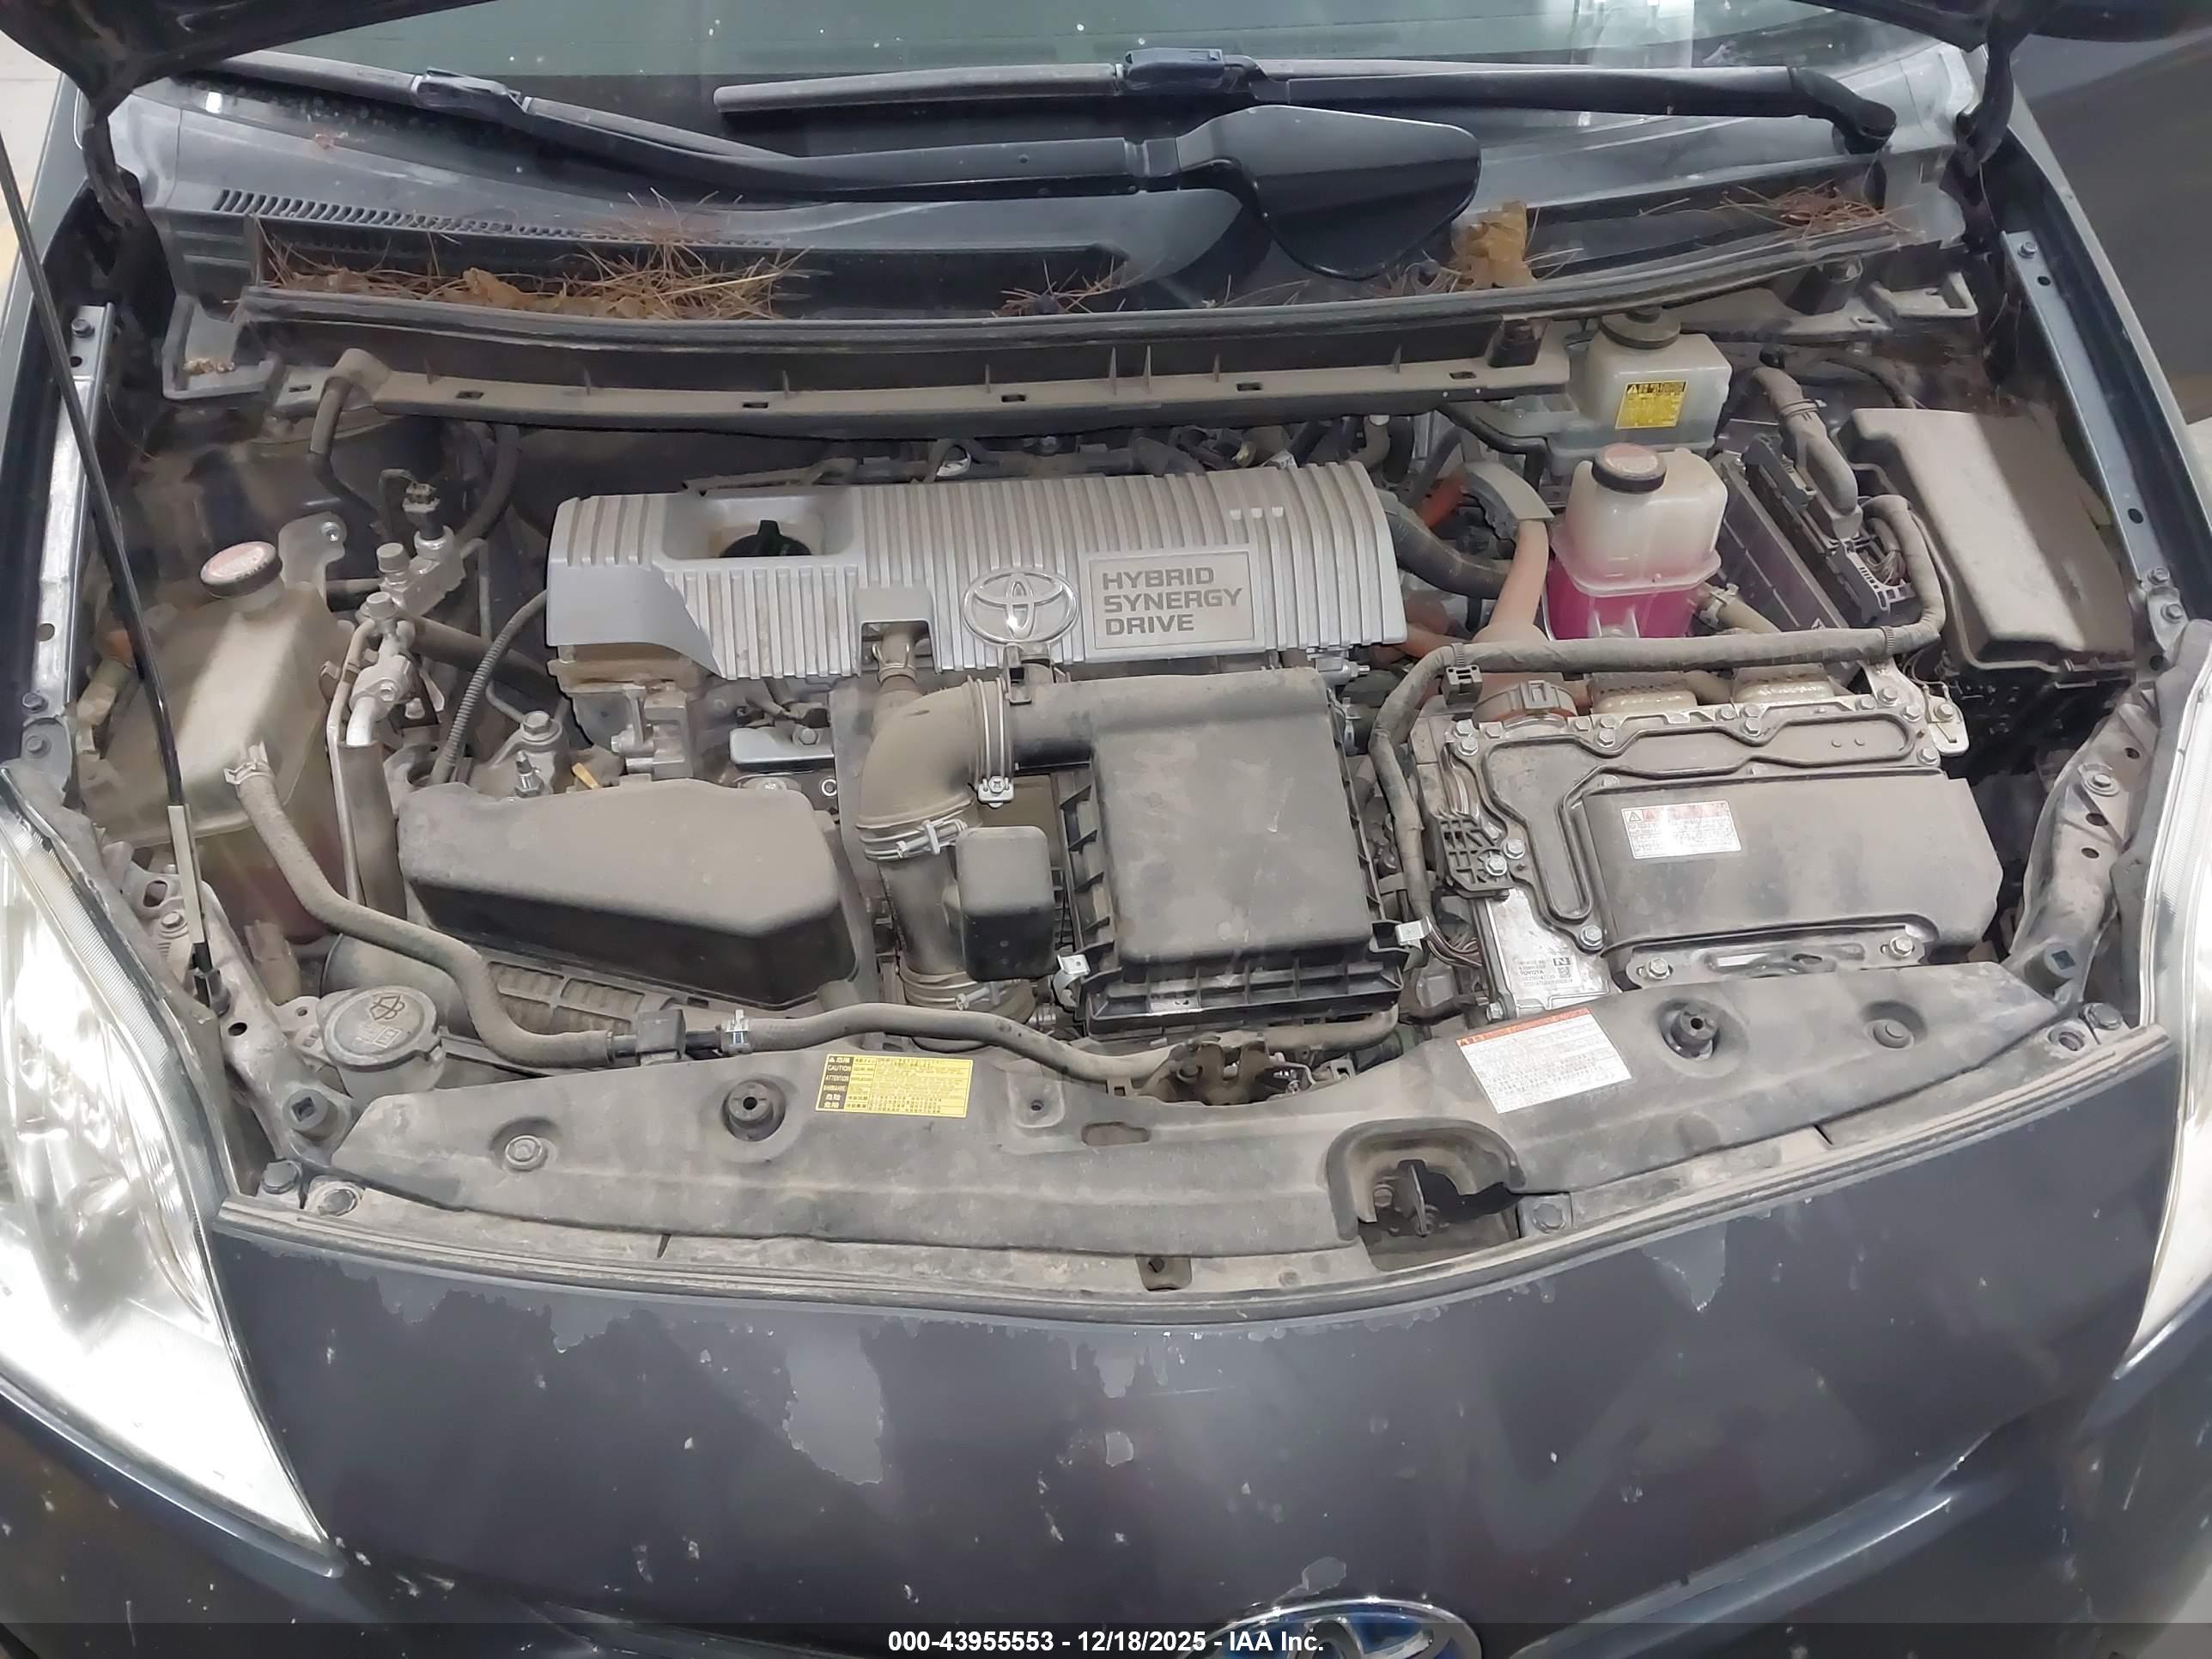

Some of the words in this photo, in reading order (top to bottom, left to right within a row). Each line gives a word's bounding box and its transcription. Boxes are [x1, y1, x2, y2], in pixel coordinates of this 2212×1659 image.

[1103, 568, 1214, 590] HYBRID
[1103, 587, 1243, 612] SYNERGY
[1105, 614, 1194, 635] DRIVE
[827, 1064, 852, 1073] CAUTION
